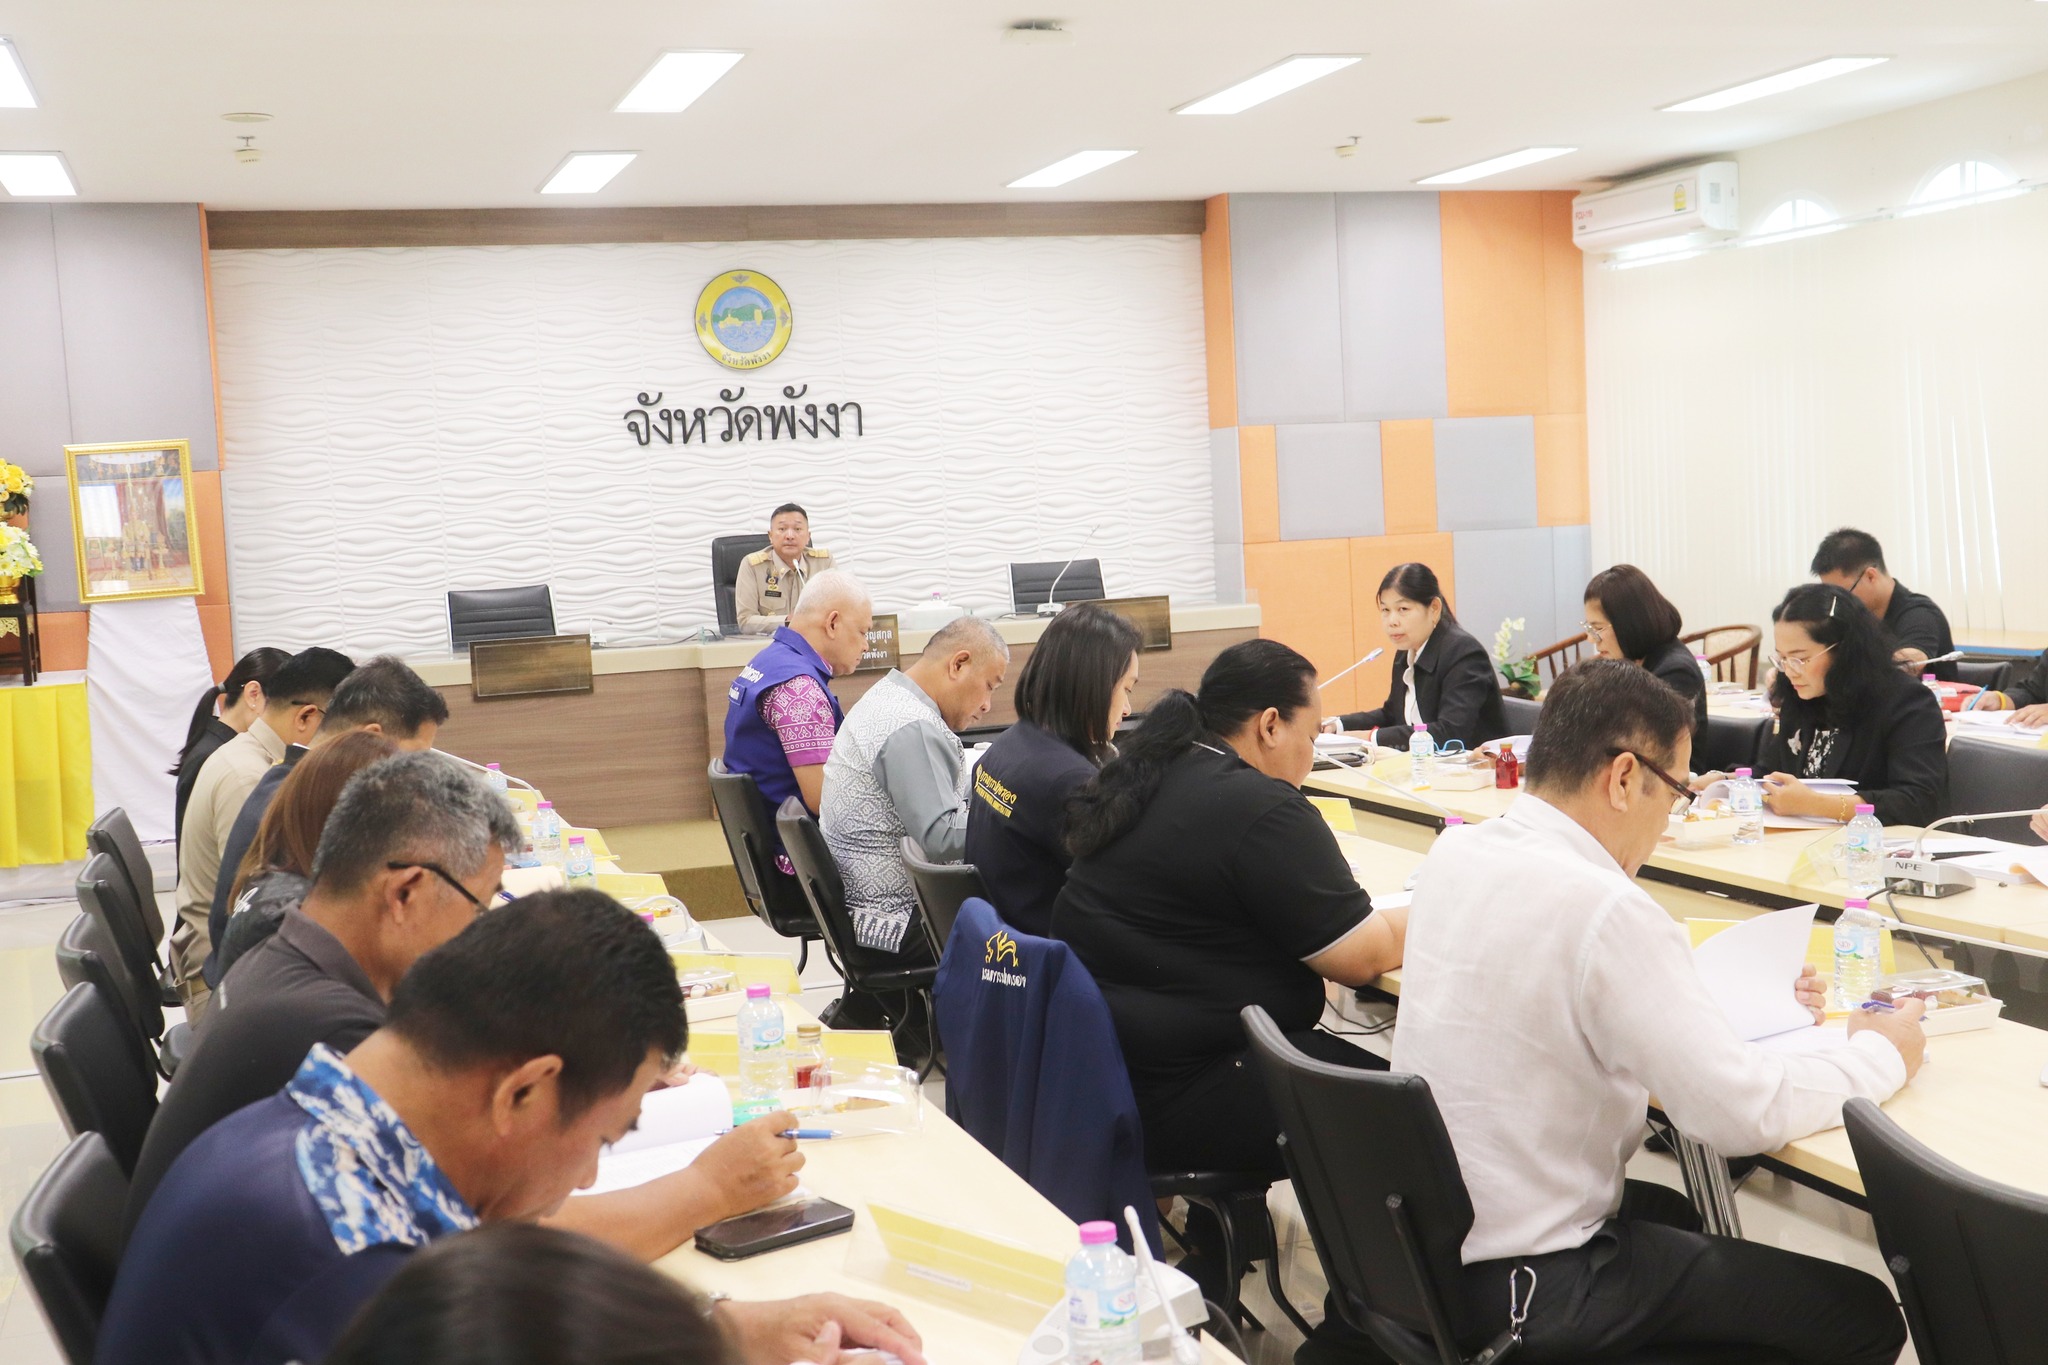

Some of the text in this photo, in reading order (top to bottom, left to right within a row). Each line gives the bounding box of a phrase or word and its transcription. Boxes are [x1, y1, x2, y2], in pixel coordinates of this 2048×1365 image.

[623, 384, 863, 446] จังหวัดพังงา
[1895, 861, 1923, 872] NPE
